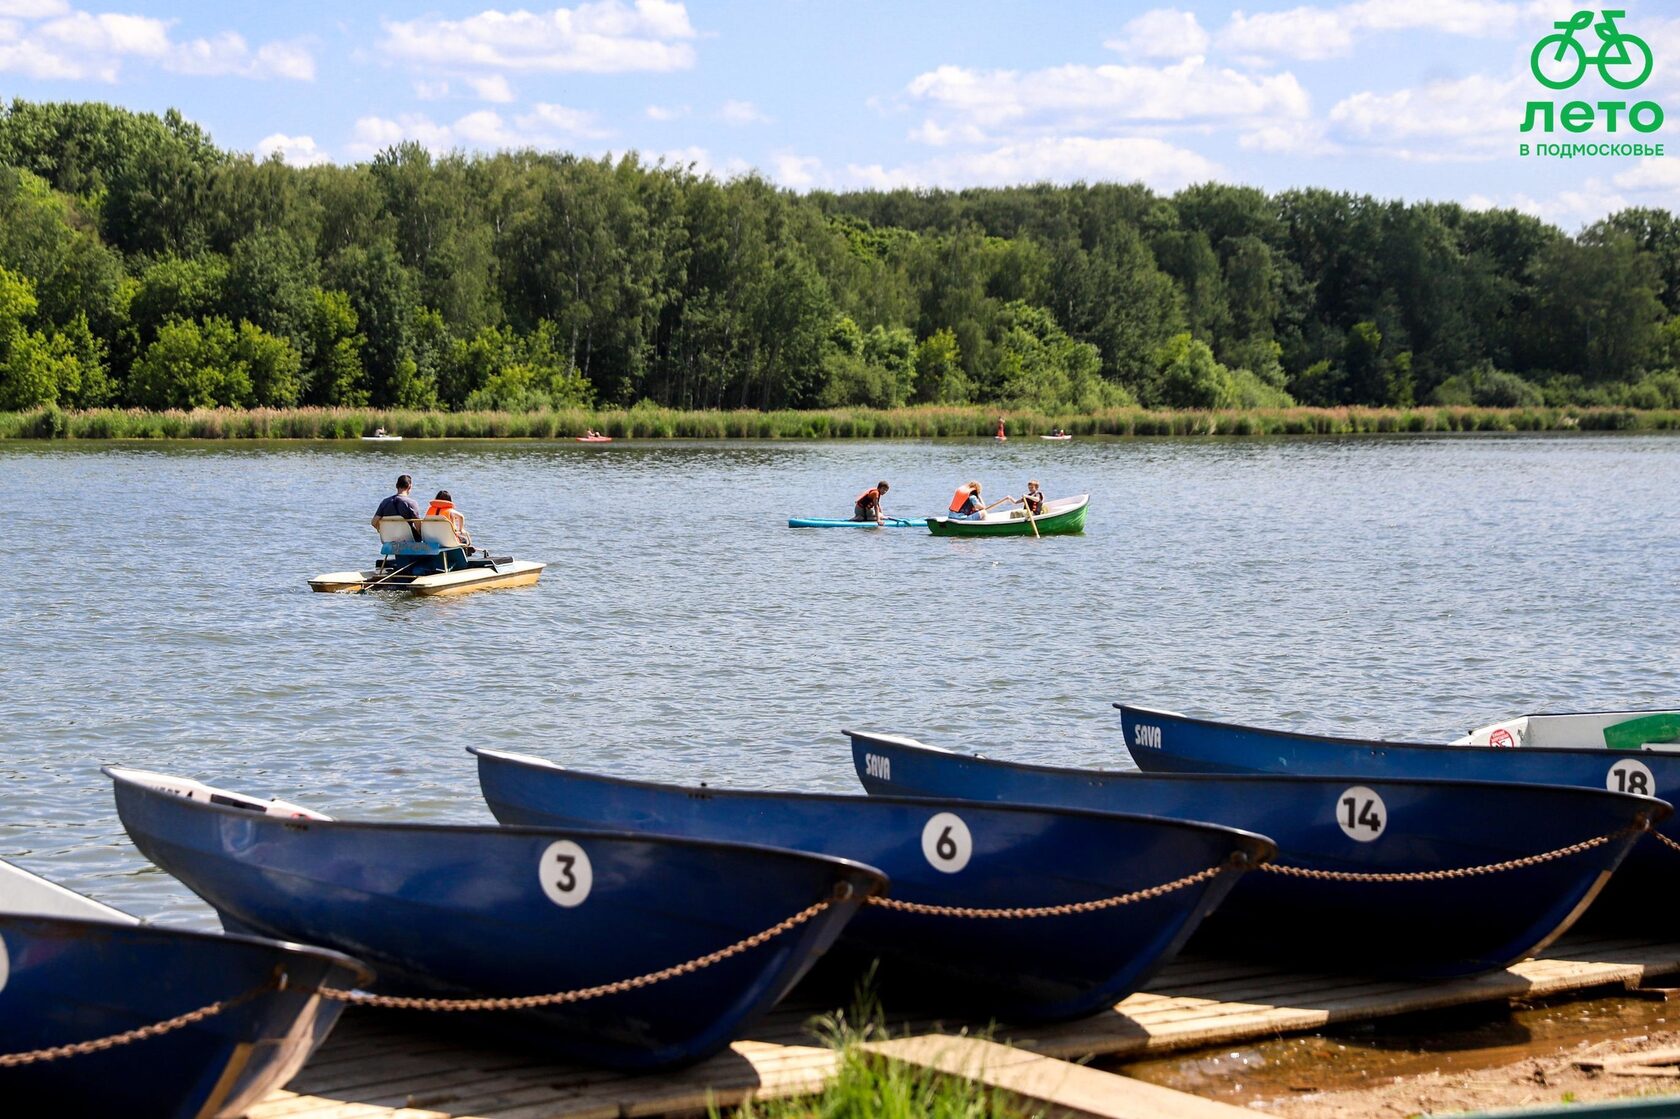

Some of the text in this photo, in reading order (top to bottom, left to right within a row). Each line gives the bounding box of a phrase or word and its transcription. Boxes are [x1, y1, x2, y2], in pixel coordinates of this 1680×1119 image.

[1135, 724, 1161, 749] SAVA
[865, 753, 890, 780] SAVA
[1613, 769, 1648, 796] 18
[1343, 797, 1381, 832] 14
[936, 826, 957, 861] 6
[556, 854, 576, 892] 3
